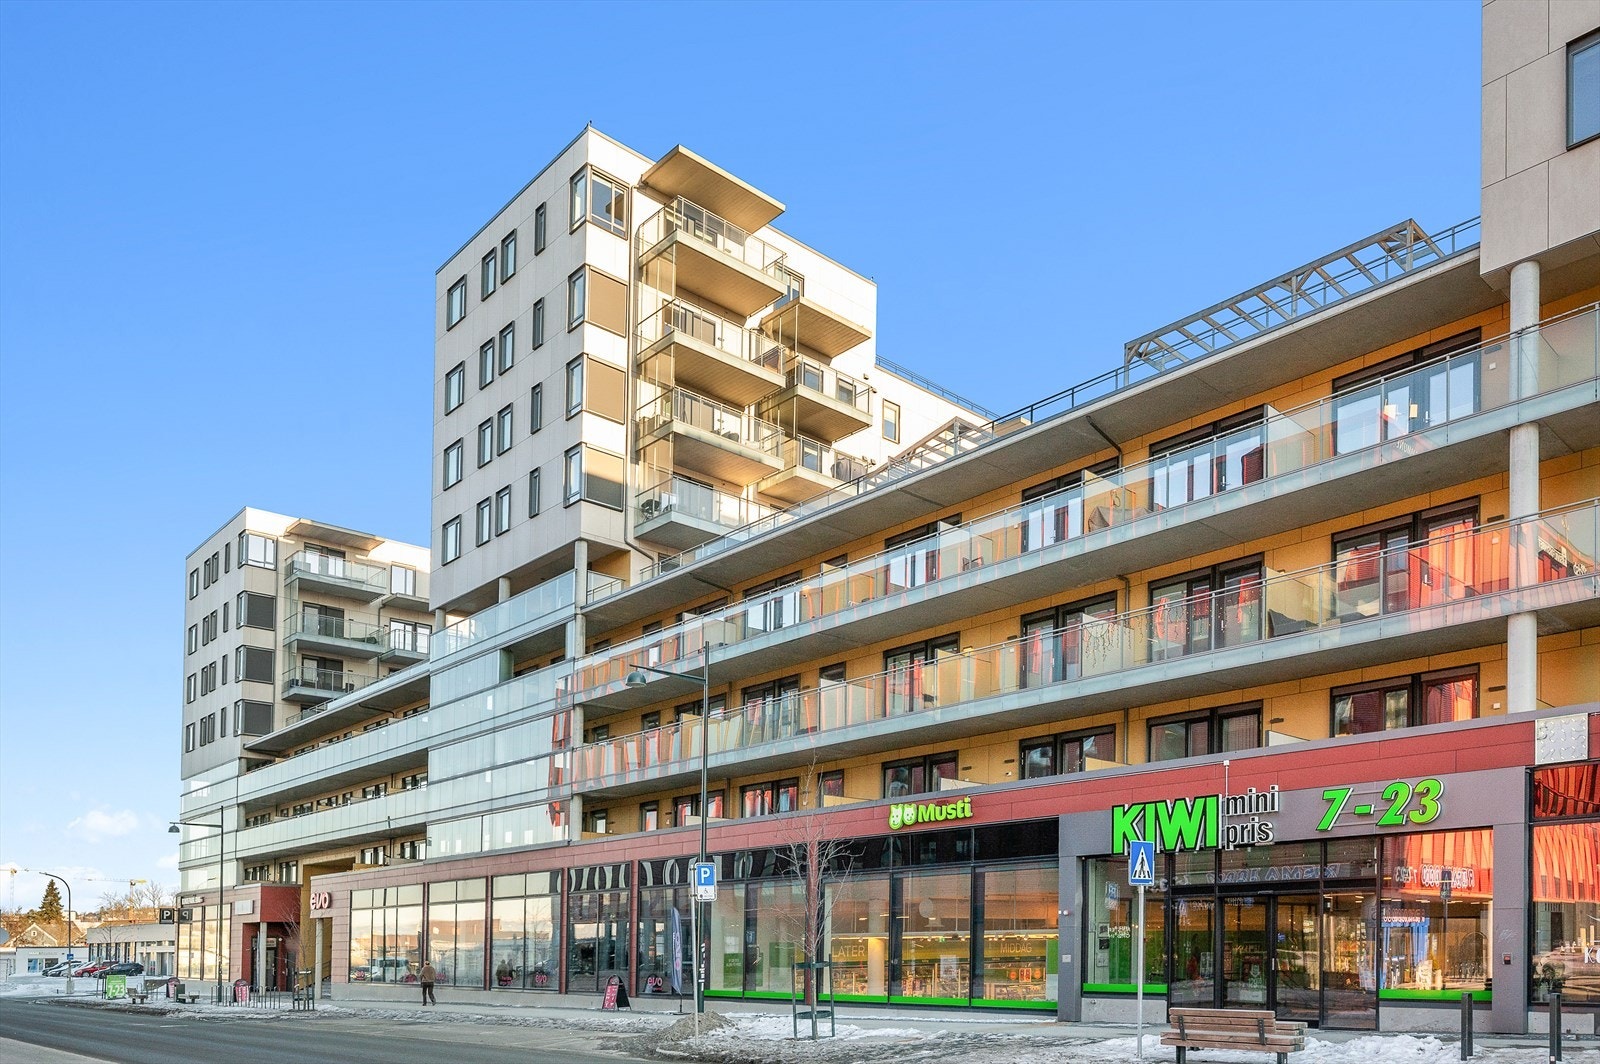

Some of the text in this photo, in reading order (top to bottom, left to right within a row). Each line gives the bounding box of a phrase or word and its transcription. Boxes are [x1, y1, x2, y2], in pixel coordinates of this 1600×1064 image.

[1225, 784, 1279, 816] mini
[917, 796, 973, 823] Musti
[1111, 793, 1223, 856] KIWI
[1225, 816, 1275, 851] pris
[701, 867, 711, 884] P
[310, 891, 330, 910] evo
[163, 910, 171, 920] P
[1000, 942, 1032, 954] MIDDAG
[108, 983, 125, 997] 7-23
[647, 976, 663, 987] evo
